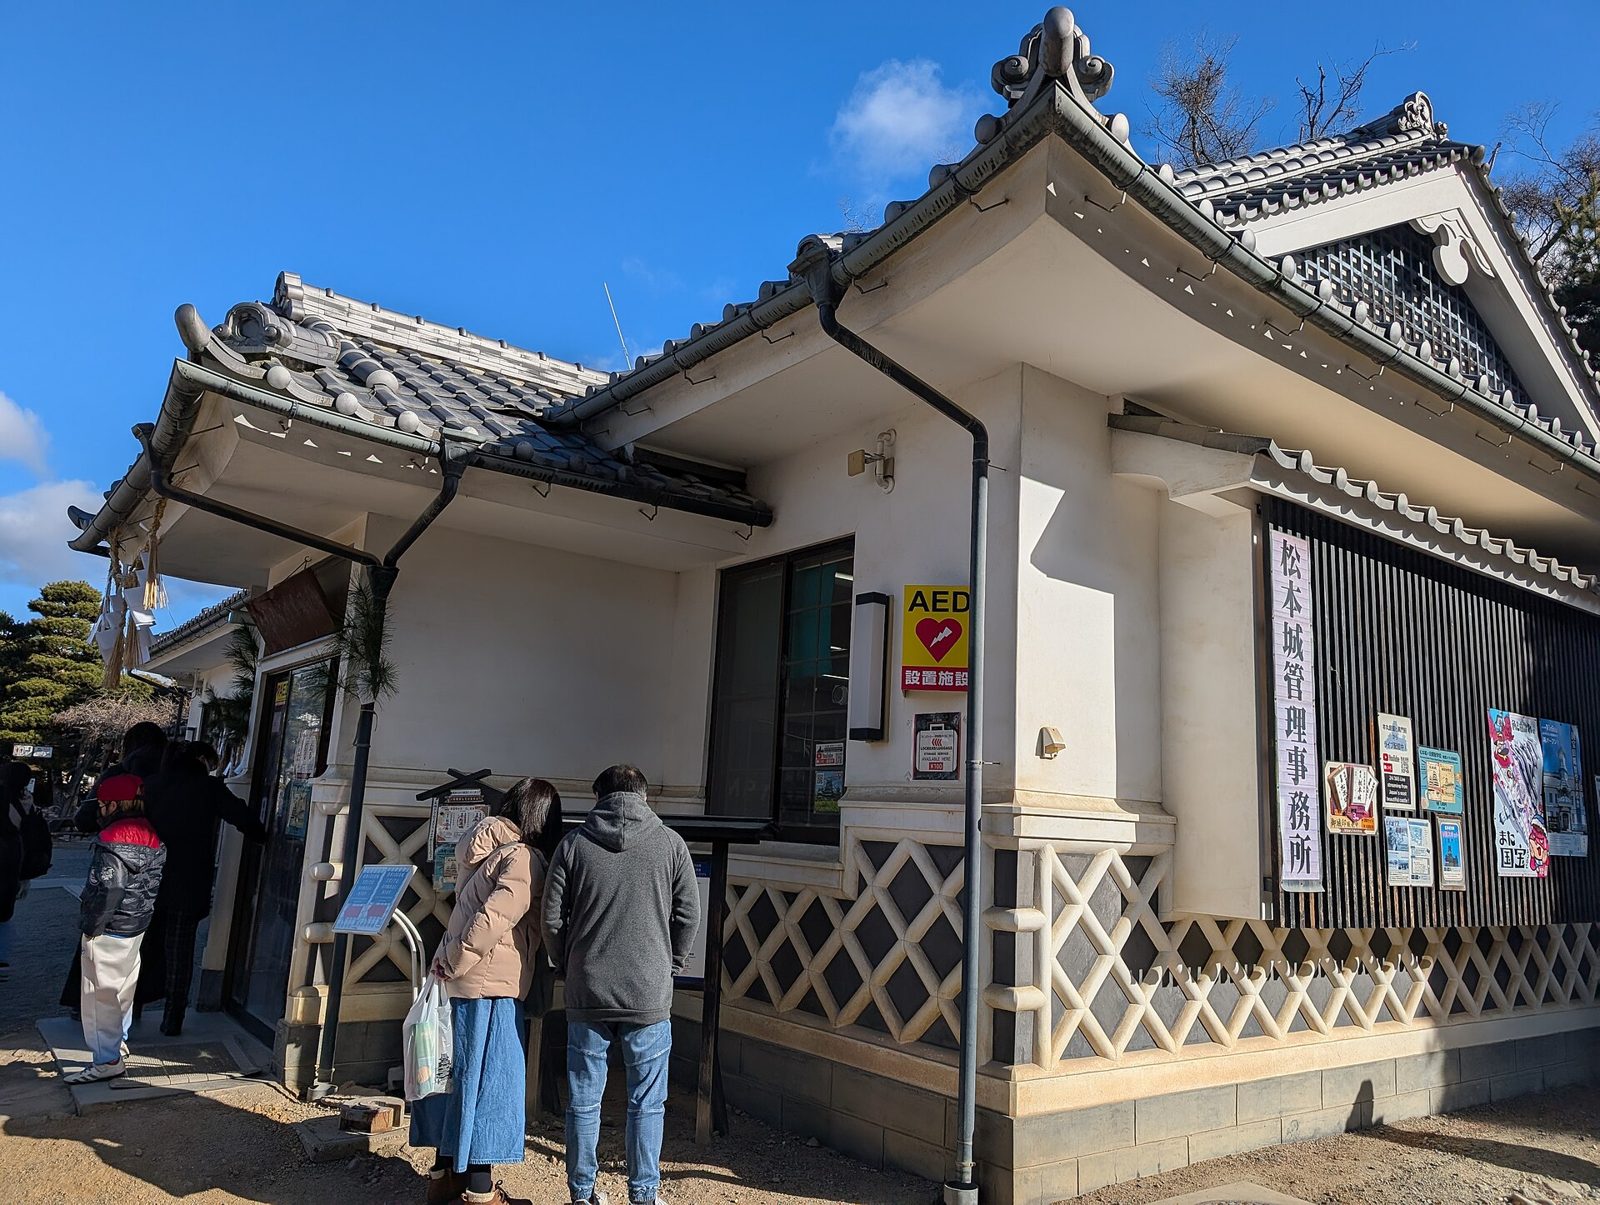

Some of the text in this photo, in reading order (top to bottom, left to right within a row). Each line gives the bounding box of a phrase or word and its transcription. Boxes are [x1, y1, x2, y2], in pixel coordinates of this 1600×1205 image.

[908, 590, 969, 613] AED
[905, 670, 968, 687] 設置施設
[1279, 538, 1311, 875] 松本城管理事務所
